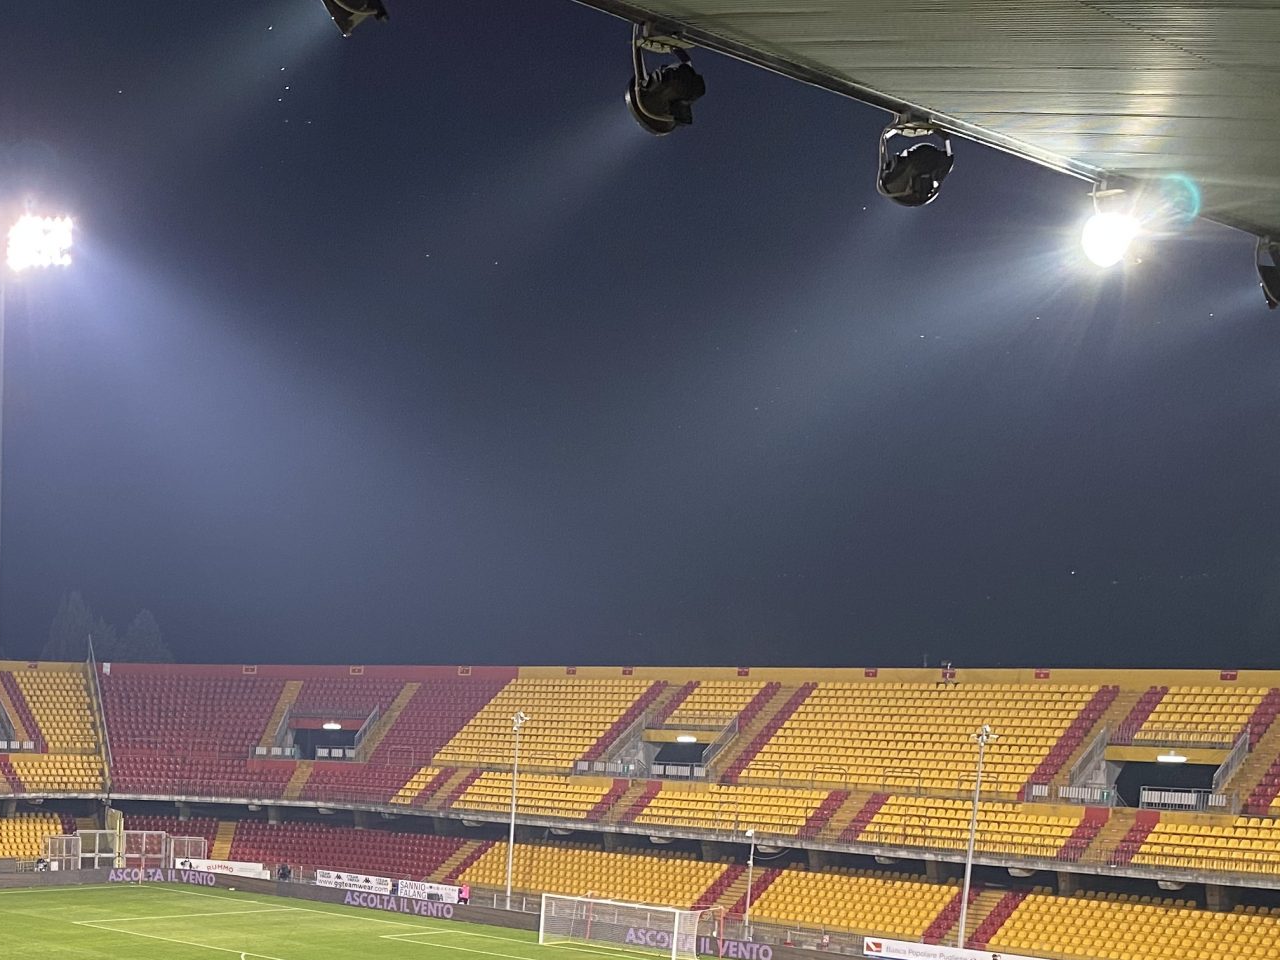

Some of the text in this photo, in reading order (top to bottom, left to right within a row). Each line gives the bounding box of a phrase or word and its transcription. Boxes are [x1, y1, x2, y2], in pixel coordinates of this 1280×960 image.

[108, 868, 216, 886] ASCOLTA IL VENTO
[207, 864, 234, 873] RUMMO
[400, 881, 426, 891] SANNIO
[344, 890, 454, 919] ASCOLTA IL VENTO
[700, 937, 714, 955] IL
